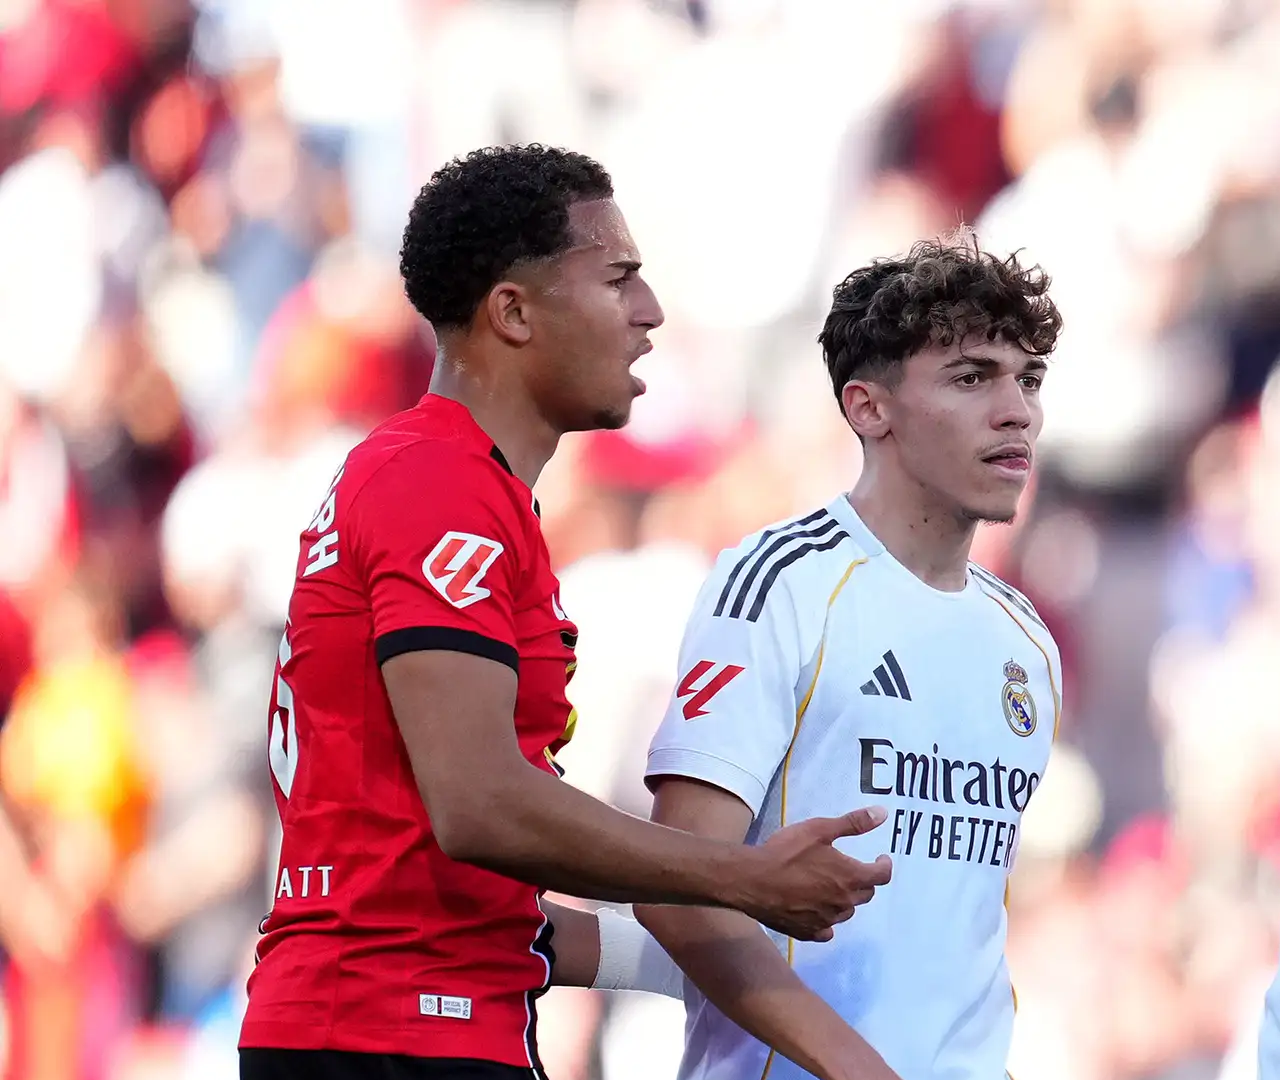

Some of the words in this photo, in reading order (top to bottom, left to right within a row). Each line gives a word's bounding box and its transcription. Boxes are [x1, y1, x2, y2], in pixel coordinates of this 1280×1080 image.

[858, 738, 1040, 813] Emirates
[890, 809, 924, 856] FY
[927, 814, 1017, 869] BETTER
